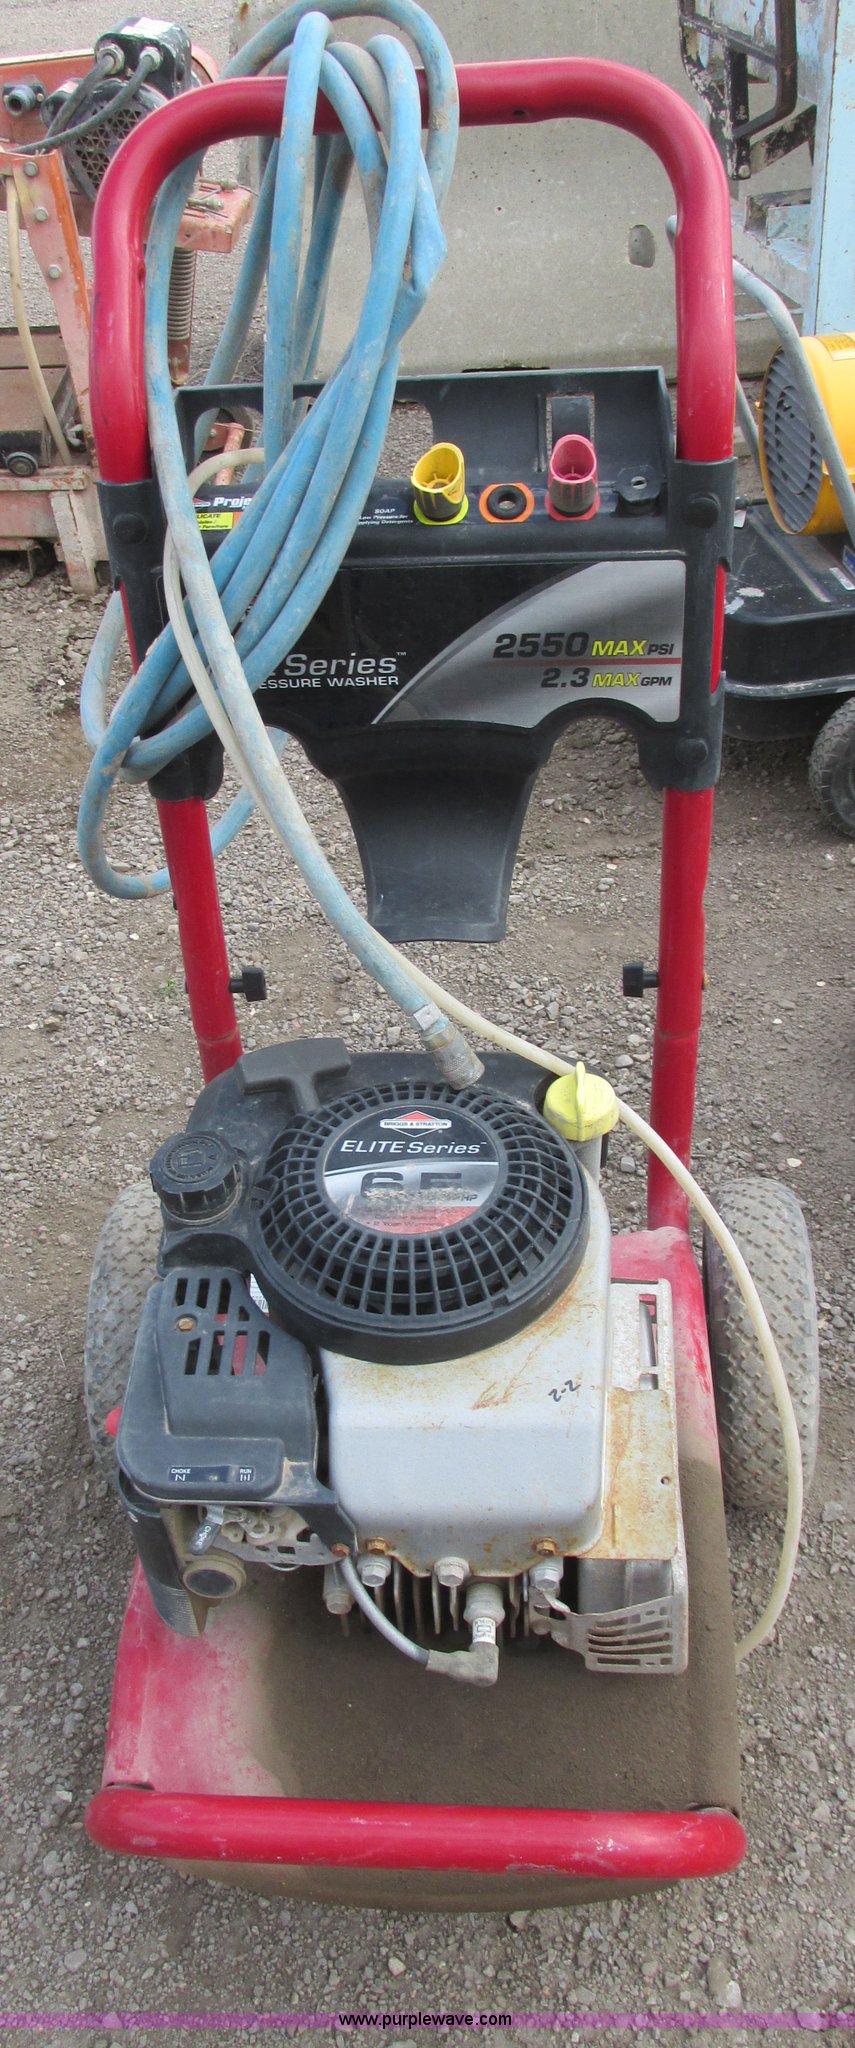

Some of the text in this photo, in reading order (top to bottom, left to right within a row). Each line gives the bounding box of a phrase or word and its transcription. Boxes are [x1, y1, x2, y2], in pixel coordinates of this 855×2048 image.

[493, 632, 675, 659] 2550 MAX PSI
[327, 676, 400, 687] WASHER
[541, 667, 673, 688] 2.3 MAX GPM
[340, 1140, 406, 1153] ELITE
[461, 1194, 478, 1202] HP
